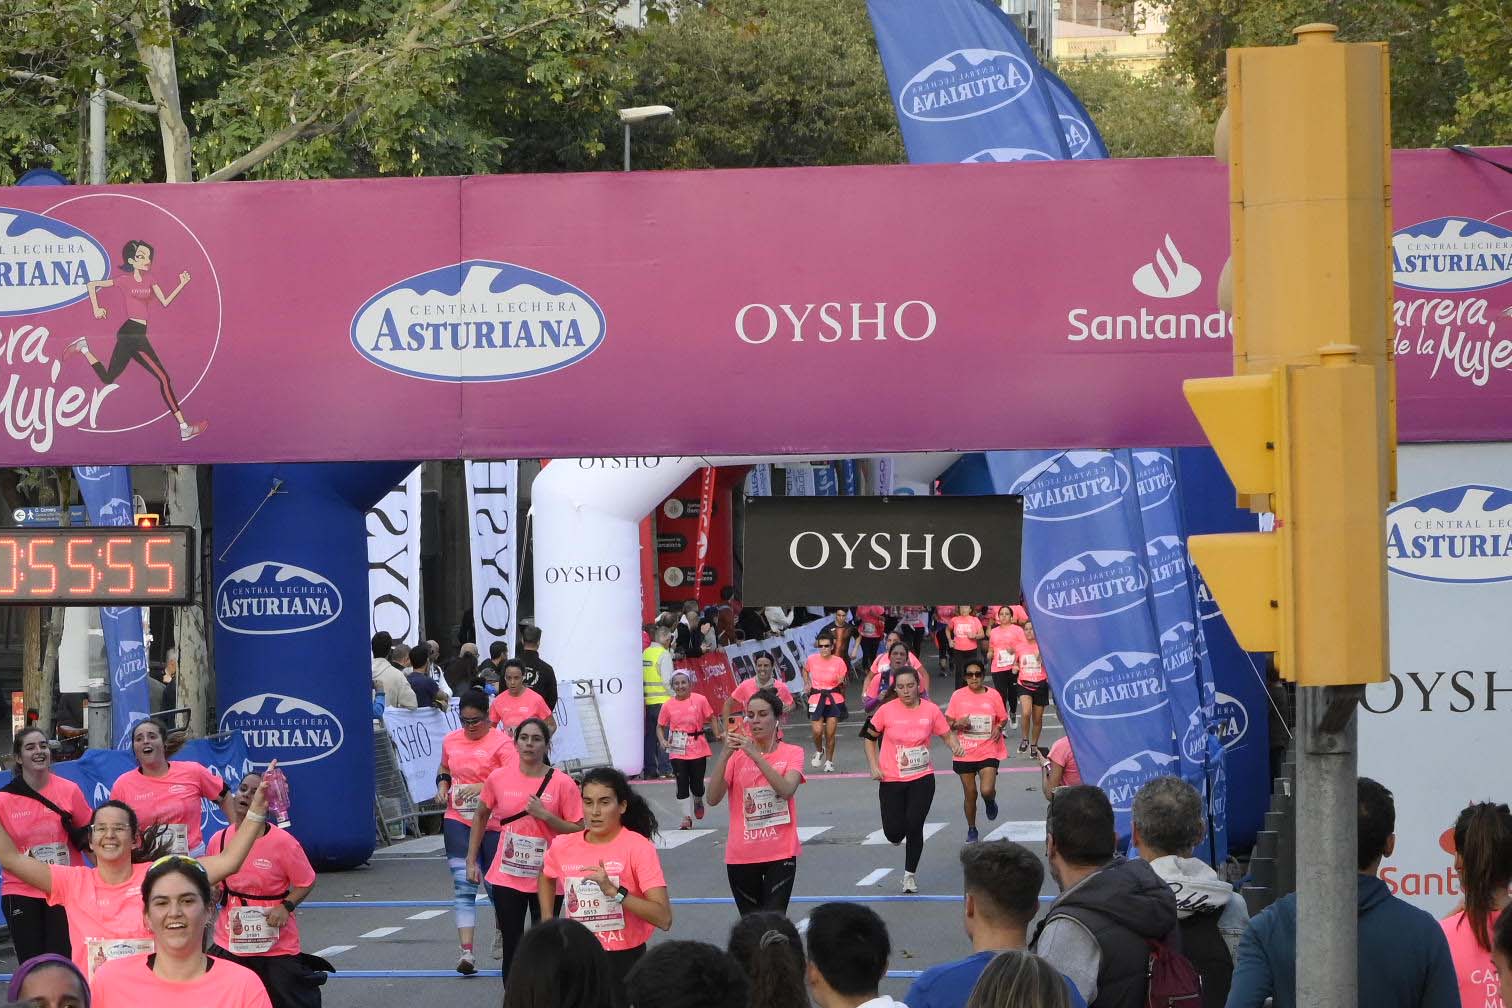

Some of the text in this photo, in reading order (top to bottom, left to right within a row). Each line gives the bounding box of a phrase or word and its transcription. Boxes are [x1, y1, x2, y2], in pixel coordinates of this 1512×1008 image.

[13, 243, 86, 255] LECHERA
[1407, 242, 1460, 250] CENTRAL
[409, 301, 578, 316] CENTRAL LECHERA
[735, 301, 937, 344] OYSHO
[370, 308, 586, 352] ASTURIANA
[1416, 328, 1435, 354] la
[1414, 520, 1481, 529] CENTRAL
[789, 531, 982, 572] OYSHO
[545, 564, 621, 584] OYSHO
[232, 586, 329, 595] CENTRAL LECHERA
[220, 592, 333, 618] ASTURIANA
[280, 718, 329, 726] LECHERA
[744, 827, 776, 840] SUMA
[515, 851, 530, 859] 016
[580, 899, 600, 908] 016
